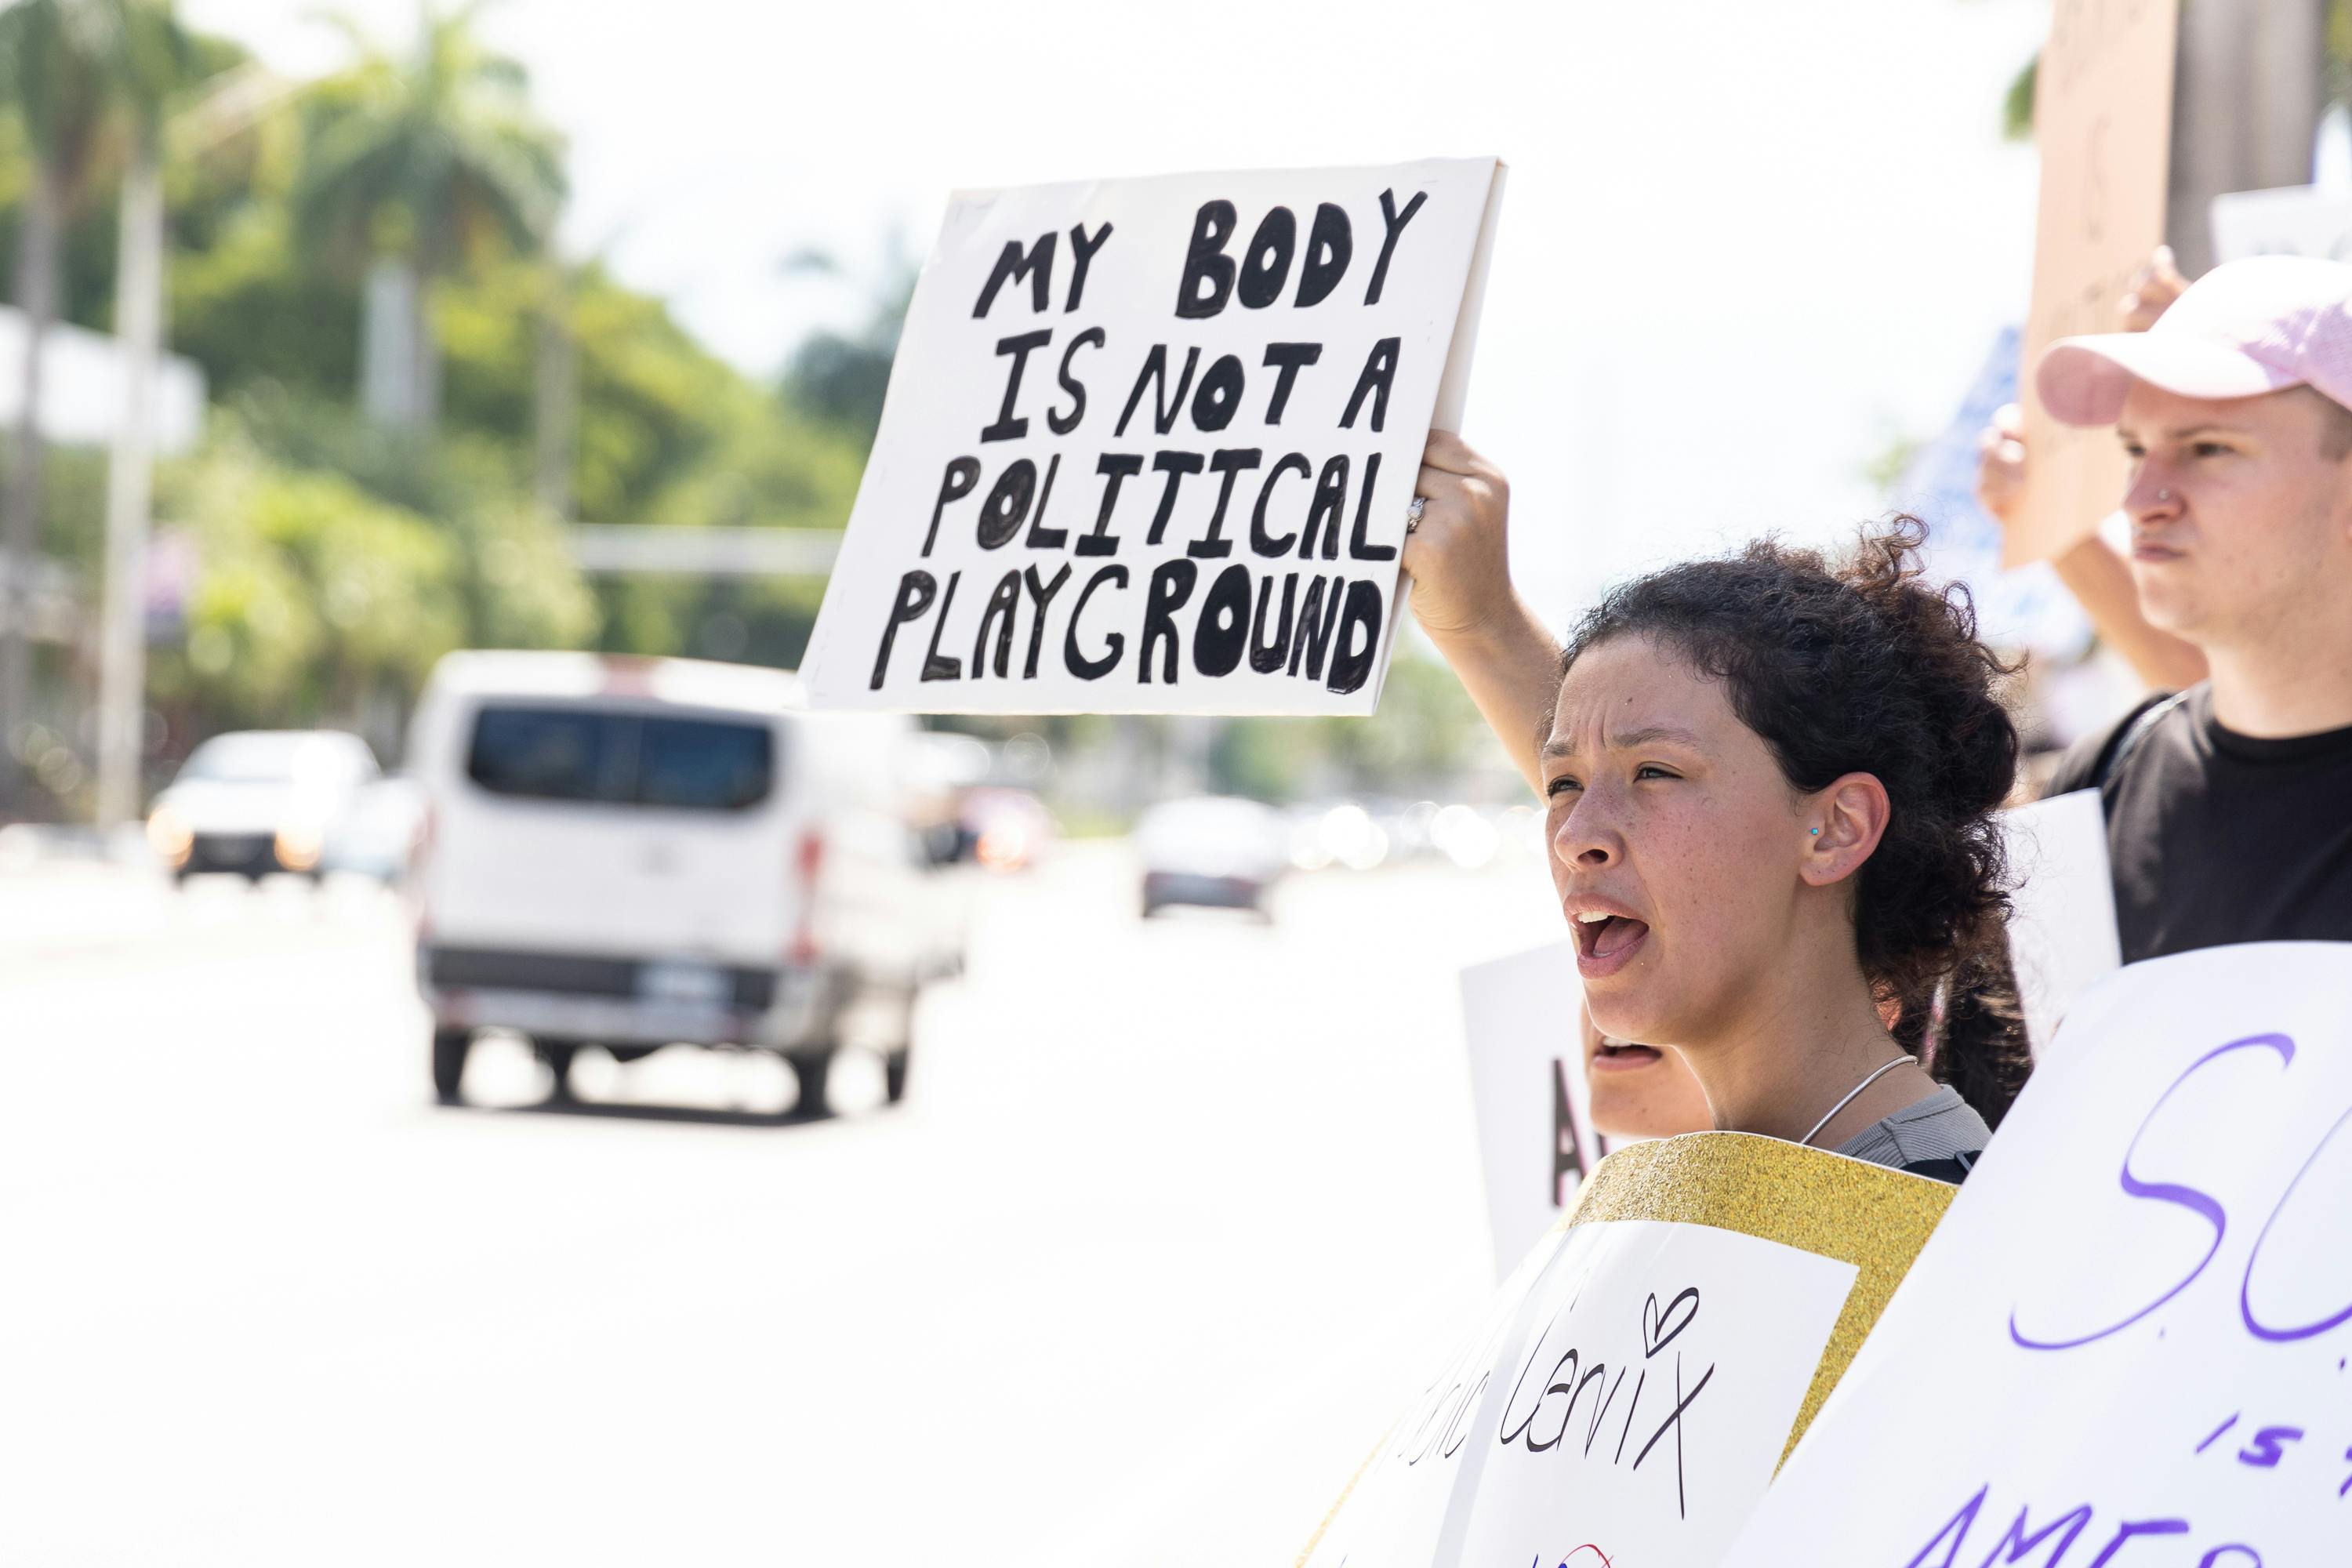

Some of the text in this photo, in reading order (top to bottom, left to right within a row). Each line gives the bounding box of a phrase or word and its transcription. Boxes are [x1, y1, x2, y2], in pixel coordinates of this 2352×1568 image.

[972, 188, 1428, 319] MY BODY
[981, 327, 1402, 444] IS NOT A
[921, 448, 1397, 561] POLITICAL
[869, 558, 1384, 695] PLAYGROUND
